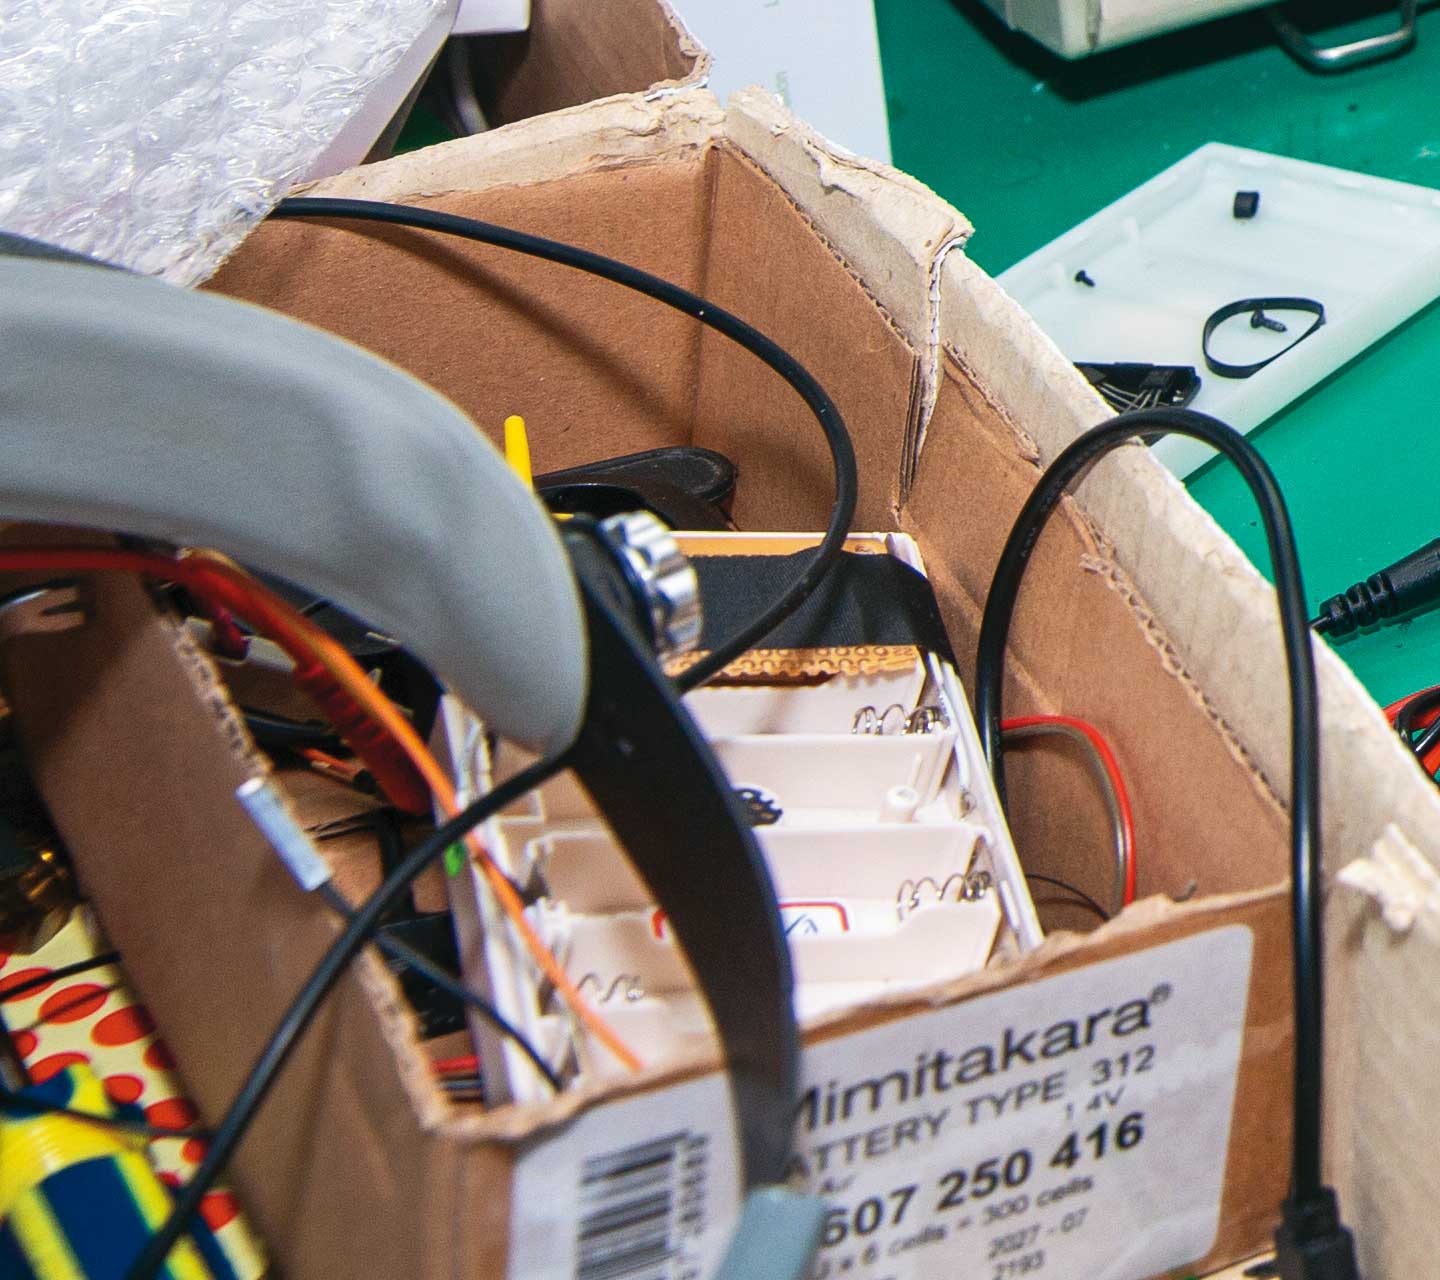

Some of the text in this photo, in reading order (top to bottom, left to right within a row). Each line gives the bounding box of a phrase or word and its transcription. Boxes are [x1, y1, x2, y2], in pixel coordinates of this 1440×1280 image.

[964, 1069, 1068, 1126] TYPE
[1090, 1044, 1155, 1088] 312
[937, 1148, 1032, 1212] 250
[1049, 1111, 1145, 1171] 416
[888, 1224, 948, 1258] cells
[983, 1194, 1029, 1227] 300
[1036, 1175, 1095, 1209] cells
